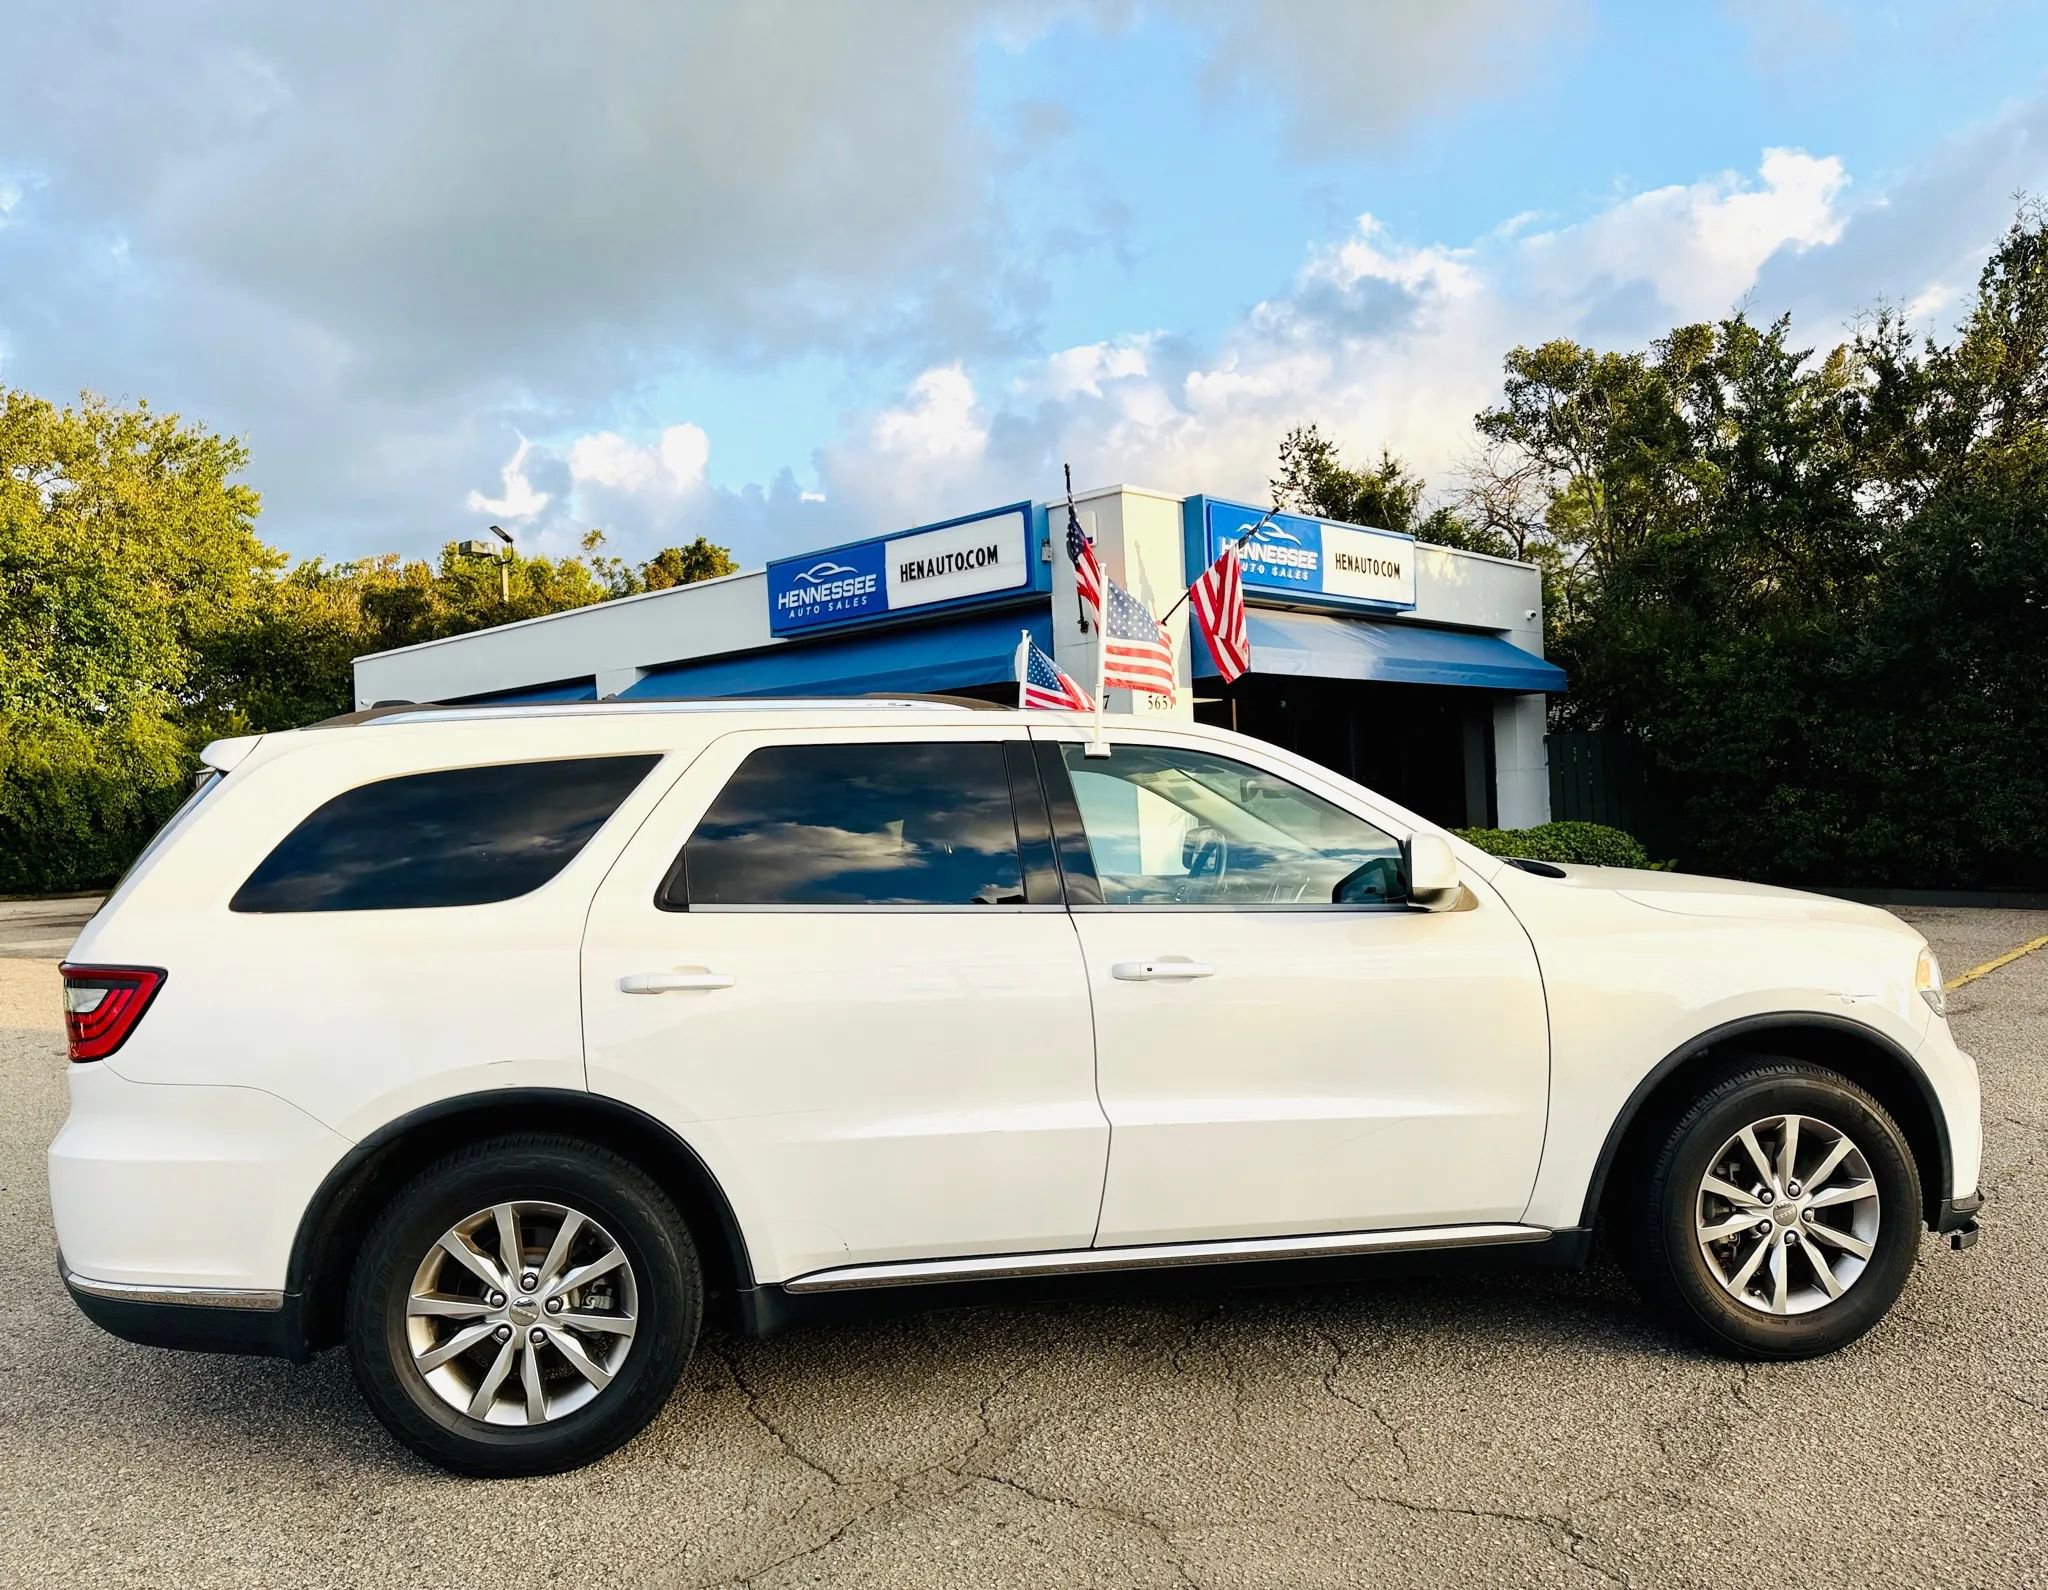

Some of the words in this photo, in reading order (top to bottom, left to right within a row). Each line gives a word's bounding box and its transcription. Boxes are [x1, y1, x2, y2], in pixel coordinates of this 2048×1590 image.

[901, 544, 998, 582] HENAUTO.COM
[1241, 562, 1266, 575] UTO
[1271, 566, 1309, 580] SALES
[779, 574, 876, 609] HENNESSEE
[789, 605, 820, 619] AUTO
[828, 596, 867, 612] SALES
